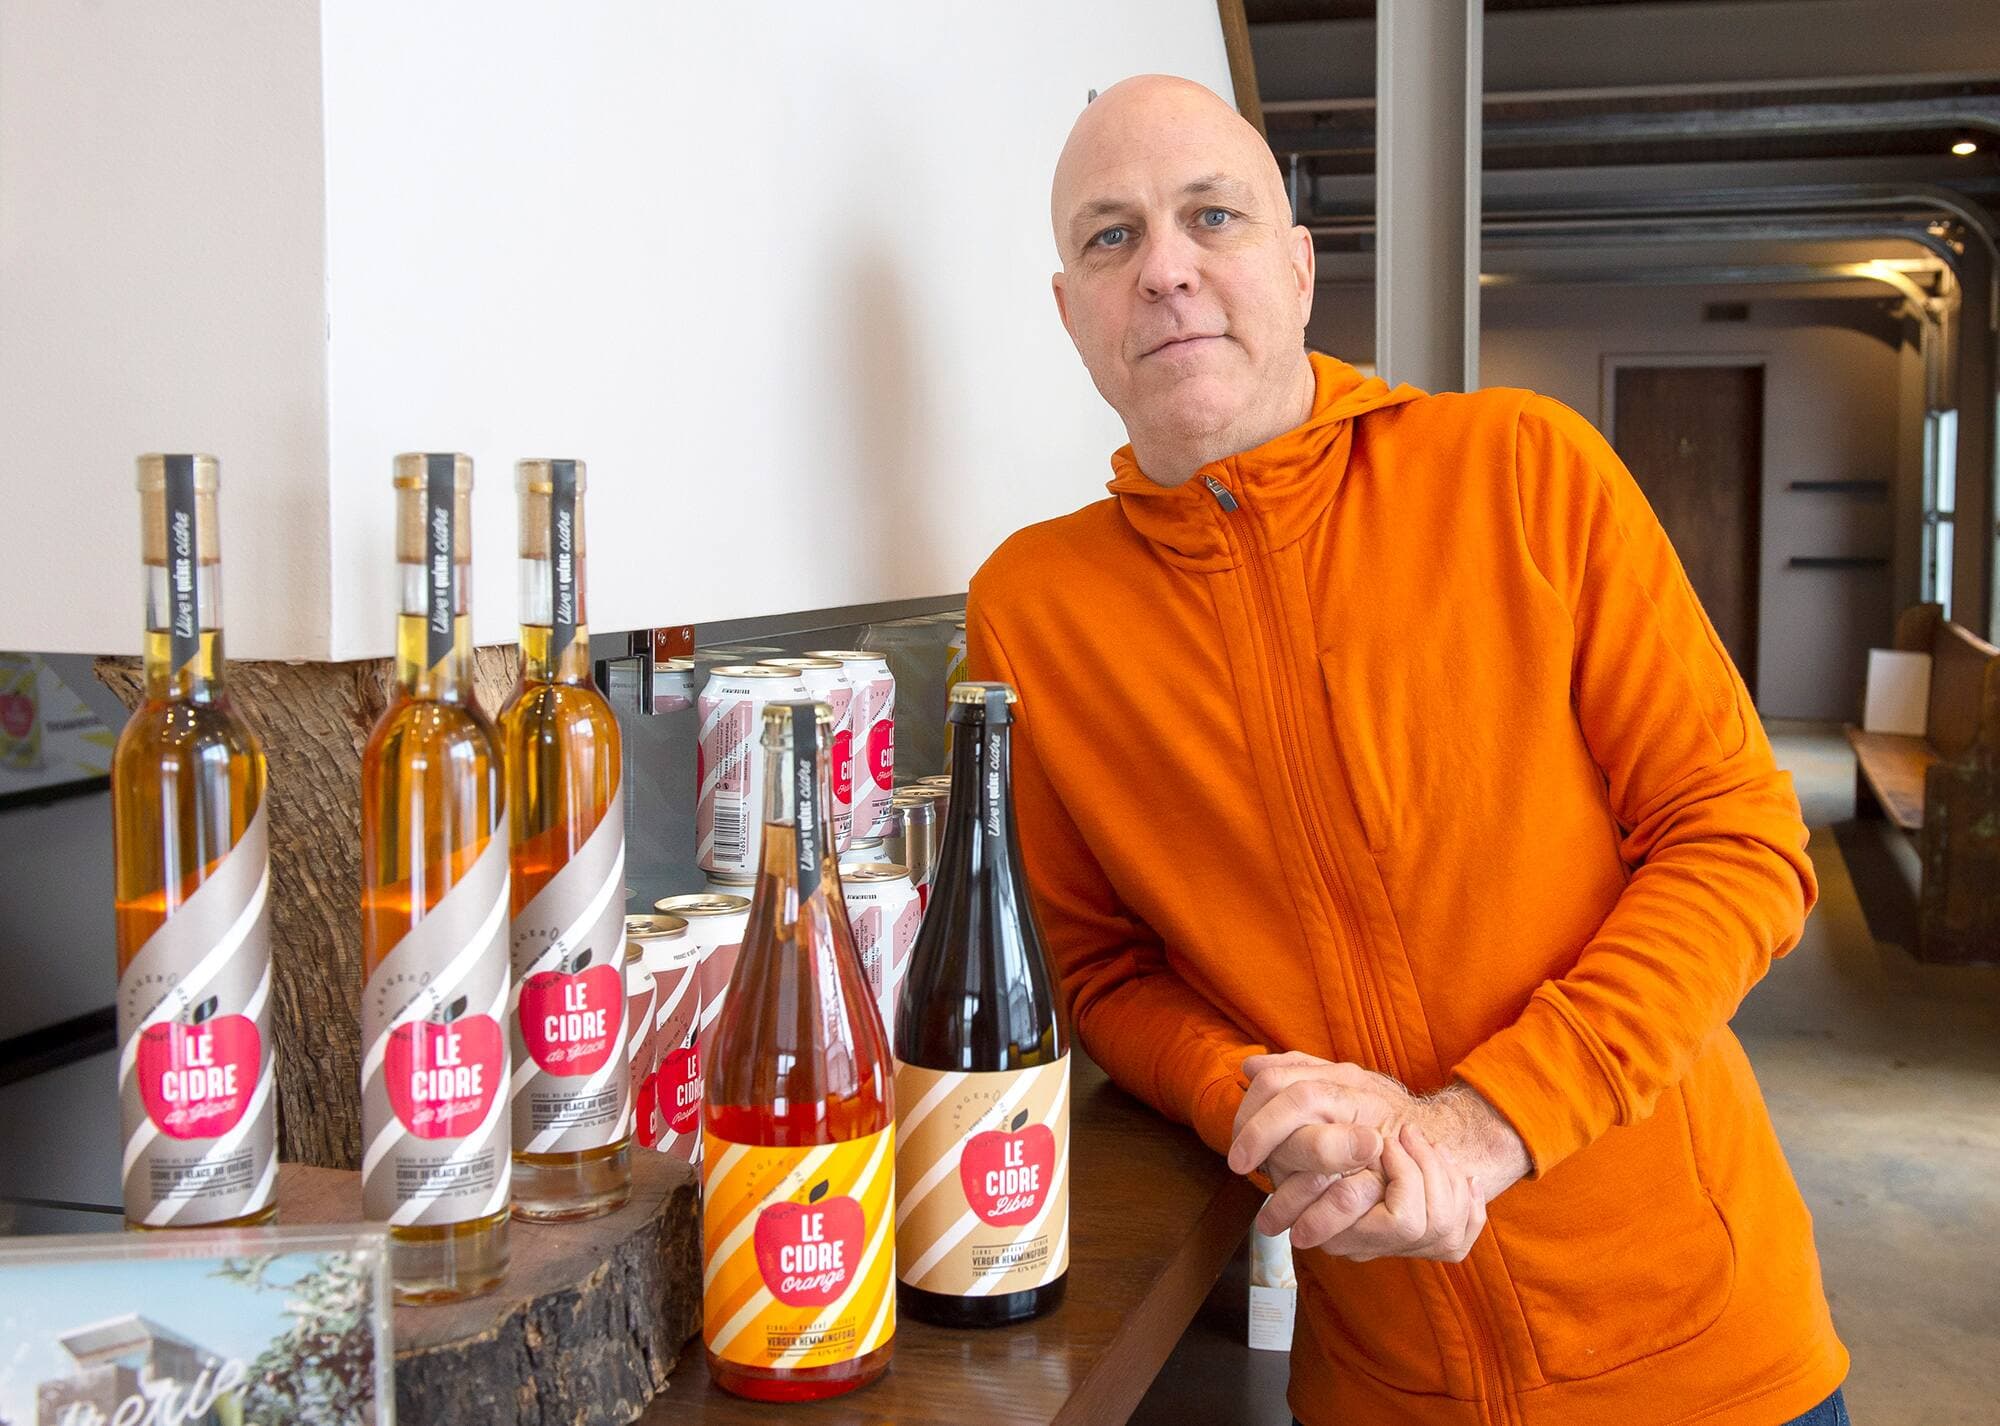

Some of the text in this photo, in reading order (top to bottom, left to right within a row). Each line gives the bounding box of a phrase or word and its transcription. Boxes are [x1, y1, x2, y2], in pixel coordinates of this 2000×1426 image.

[565, 982, 588, 1012] LE
[544, 1008, 607, 1043] CIDRE
[185, 1034, 215, 1068] LE
[435, 1034, 462, 1067] LE
[545, 1039, 607, 1063] de Glace
[686, 1053, 698, 1080] LE
[161, 1063, 239, 1103] CIDRE
[411, 1063, 484, 1102] CIDRE
[1004, 1139, 1025, 1168] LE
[985, 1164, 1040, 1197] CIDRE
[987, 1193, 1035, 1217] Libre
[801, 1212, 825, 1242] LE
[780, 1240, 844, 1274] CIDRE
[972, 1256, 1000, 1267] VERGER
[1001, 1246, 1049, 1264] HEMMINGFORD
[780, 1268, 846, 1293] Orange
[767, 1328, 856, 1347] VERGER HEMMINGFORD
